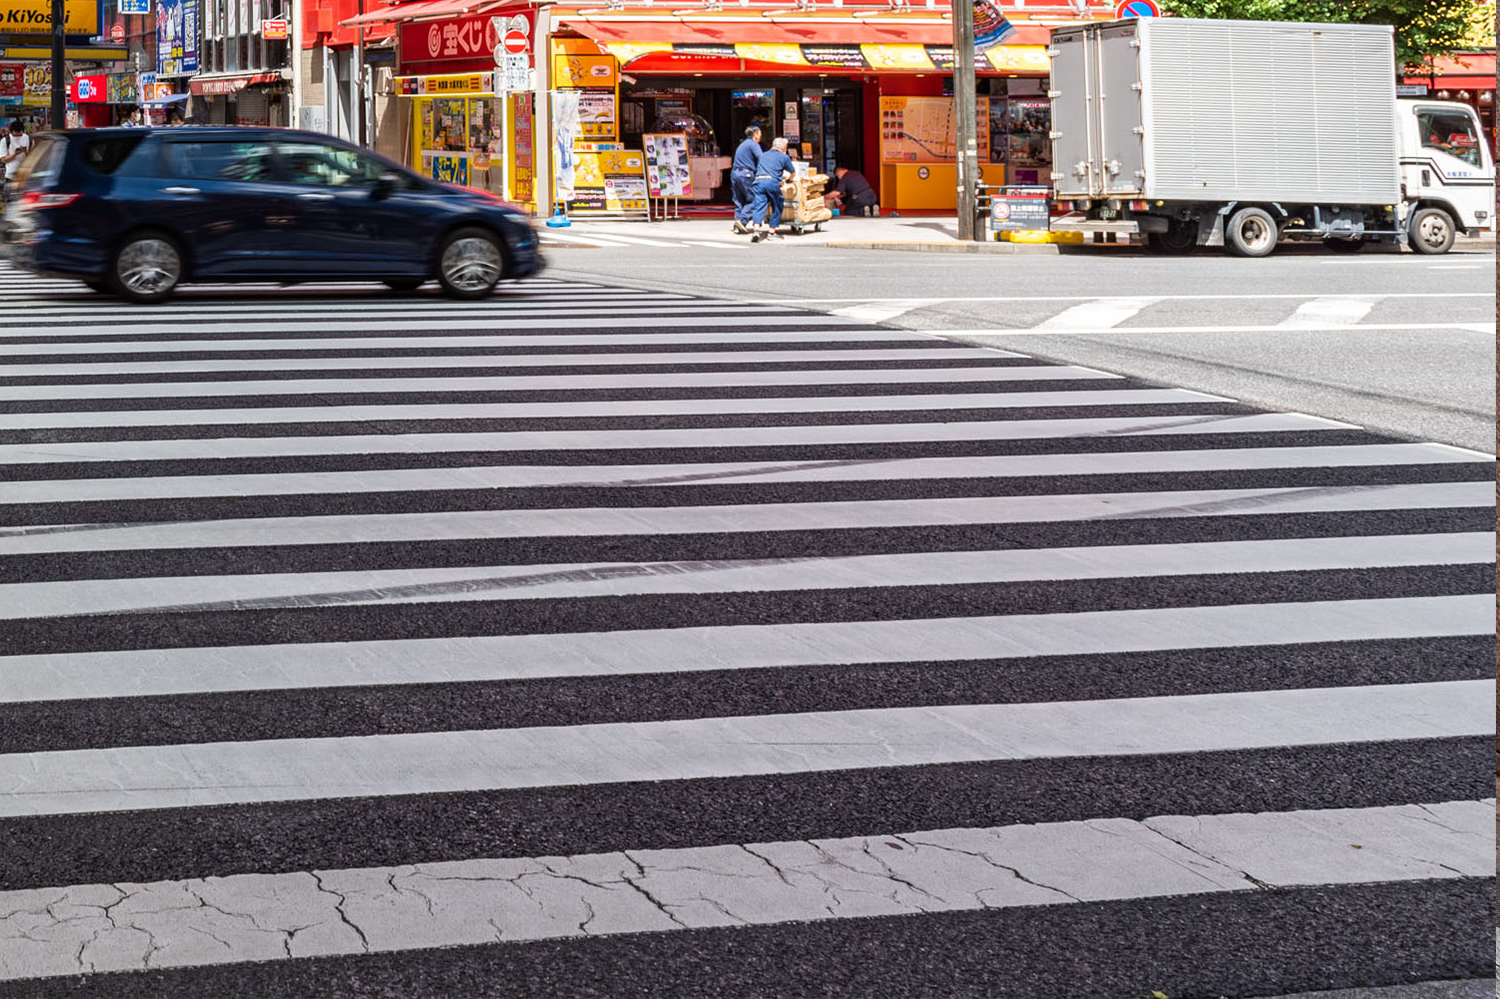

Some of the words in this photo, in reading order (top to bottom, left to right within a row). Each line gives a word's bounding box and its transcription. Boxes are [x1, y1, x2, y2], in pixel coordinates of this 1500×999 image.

[6, 9, 71, 24] KiYosi
[443, 20, 482, 56] 宝くじ
